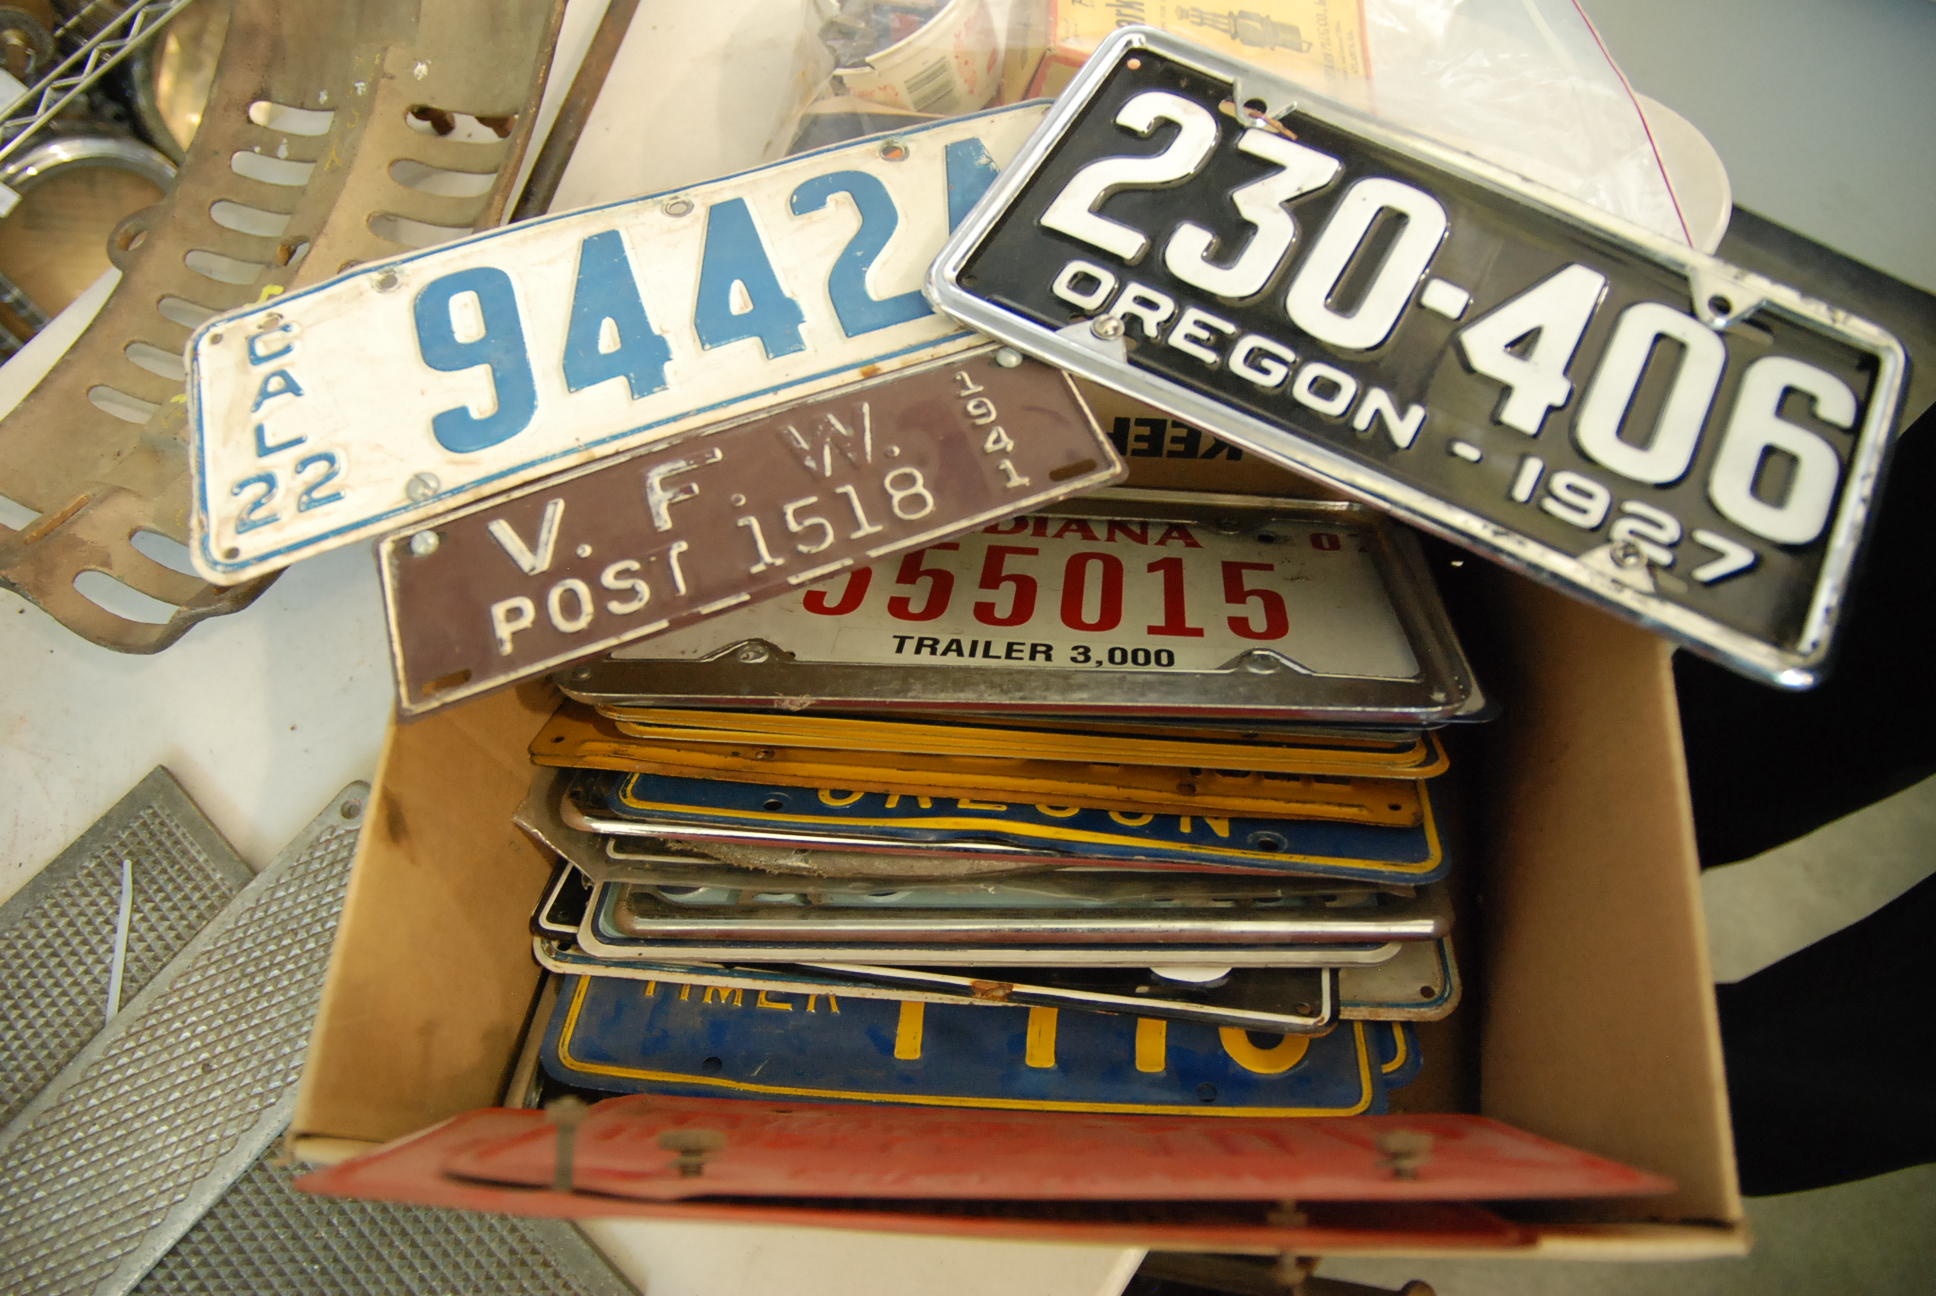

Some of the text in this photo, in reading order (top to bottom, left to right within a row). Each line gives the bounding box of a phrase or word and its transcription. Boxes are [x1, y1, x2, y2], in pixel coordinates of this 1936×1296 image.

[1040, 91, 1857, 546] 230-406
[247, 323, 307, 458] CAL
[954, 370, 1031, 488] 1941
[1051, 259, 1427, 450] OREGON
[1511, 455, 1757, 583] 1927
[230, 452, 345, 536] 22
[491, 466, 935, 657] POST 1518
[891, 634, 1176, 669] TRAILER 3,000
